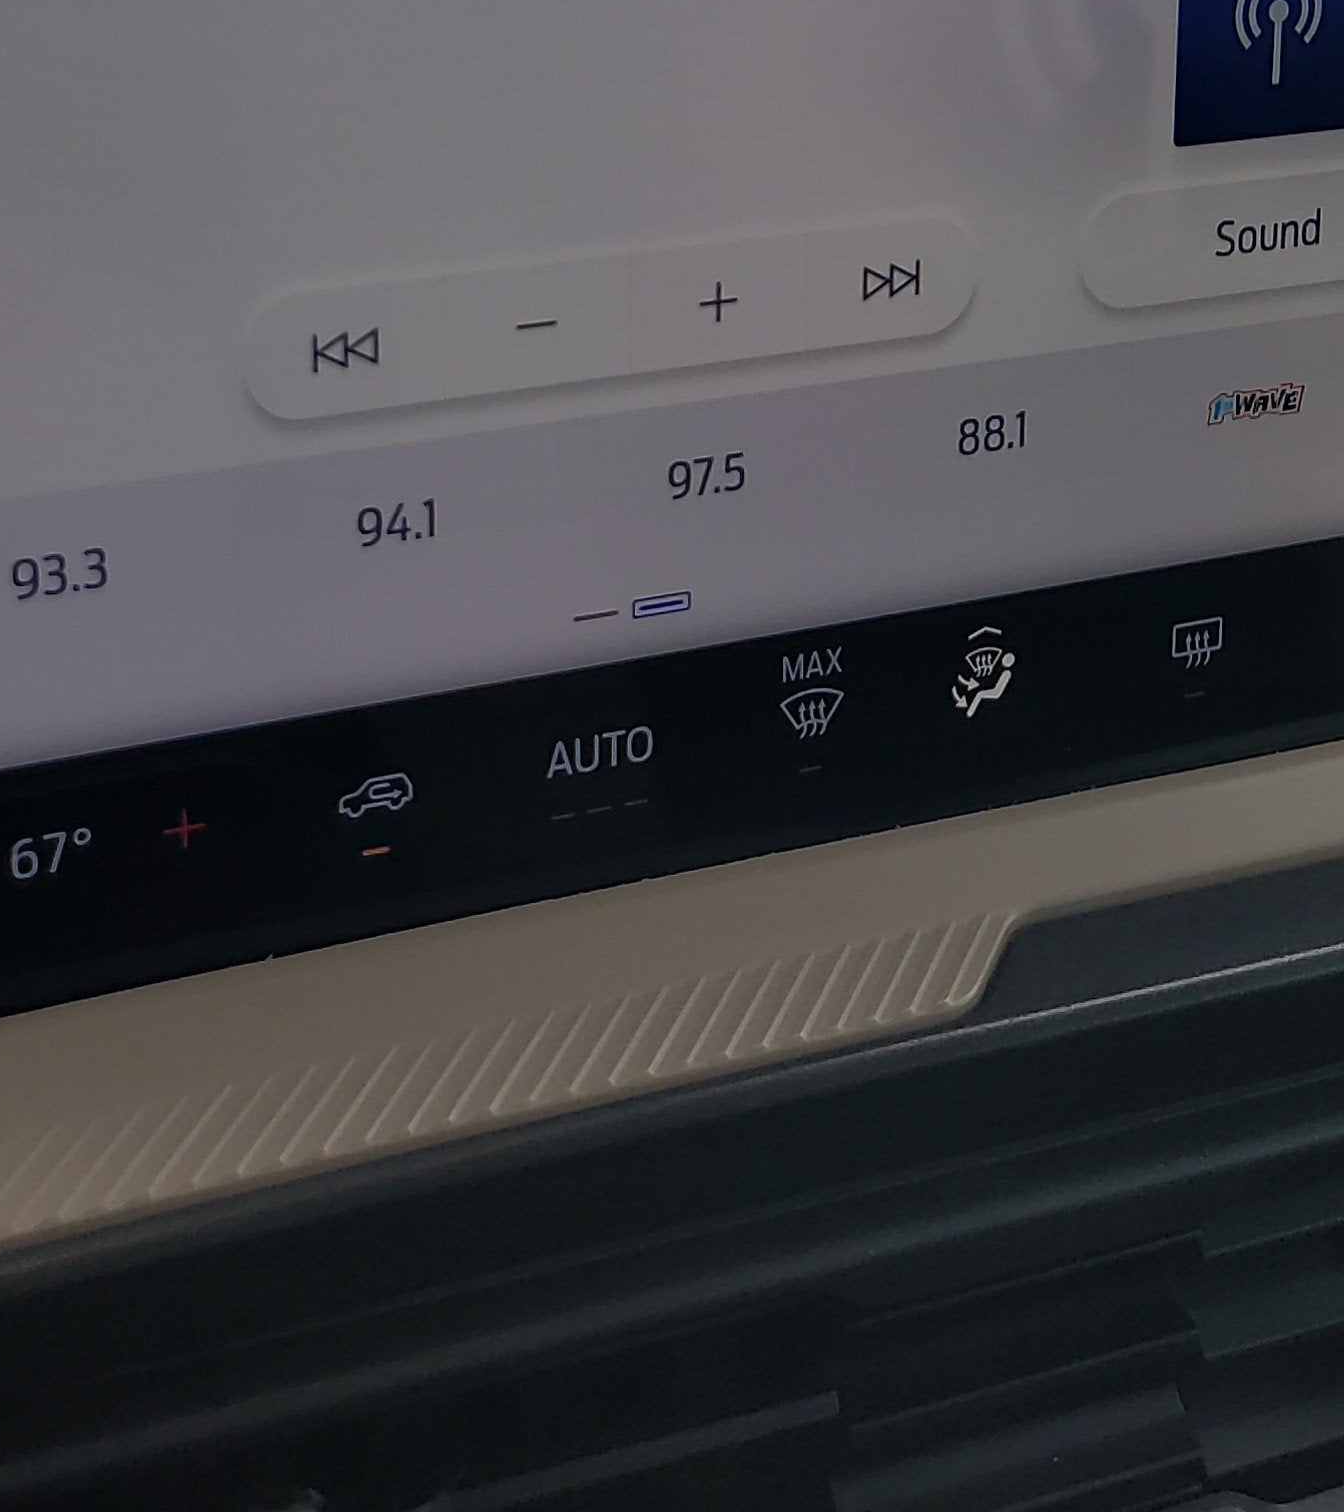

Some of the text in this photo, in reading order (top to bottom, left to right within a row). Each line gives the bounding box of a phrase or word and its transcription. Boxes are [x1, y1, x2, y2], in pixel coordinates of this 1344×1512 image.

[1216, 208, 1321, 256] Sound
[959, 411, 1025, 455] 88.1
[669, 453, 744, 500] 97.5
[358, 499, 434, 547] 94.1
[13, 548, 106, 600] 93.3
[783, 647, 843, 683] MAX
[547, 726, 653, 779] AUTO
